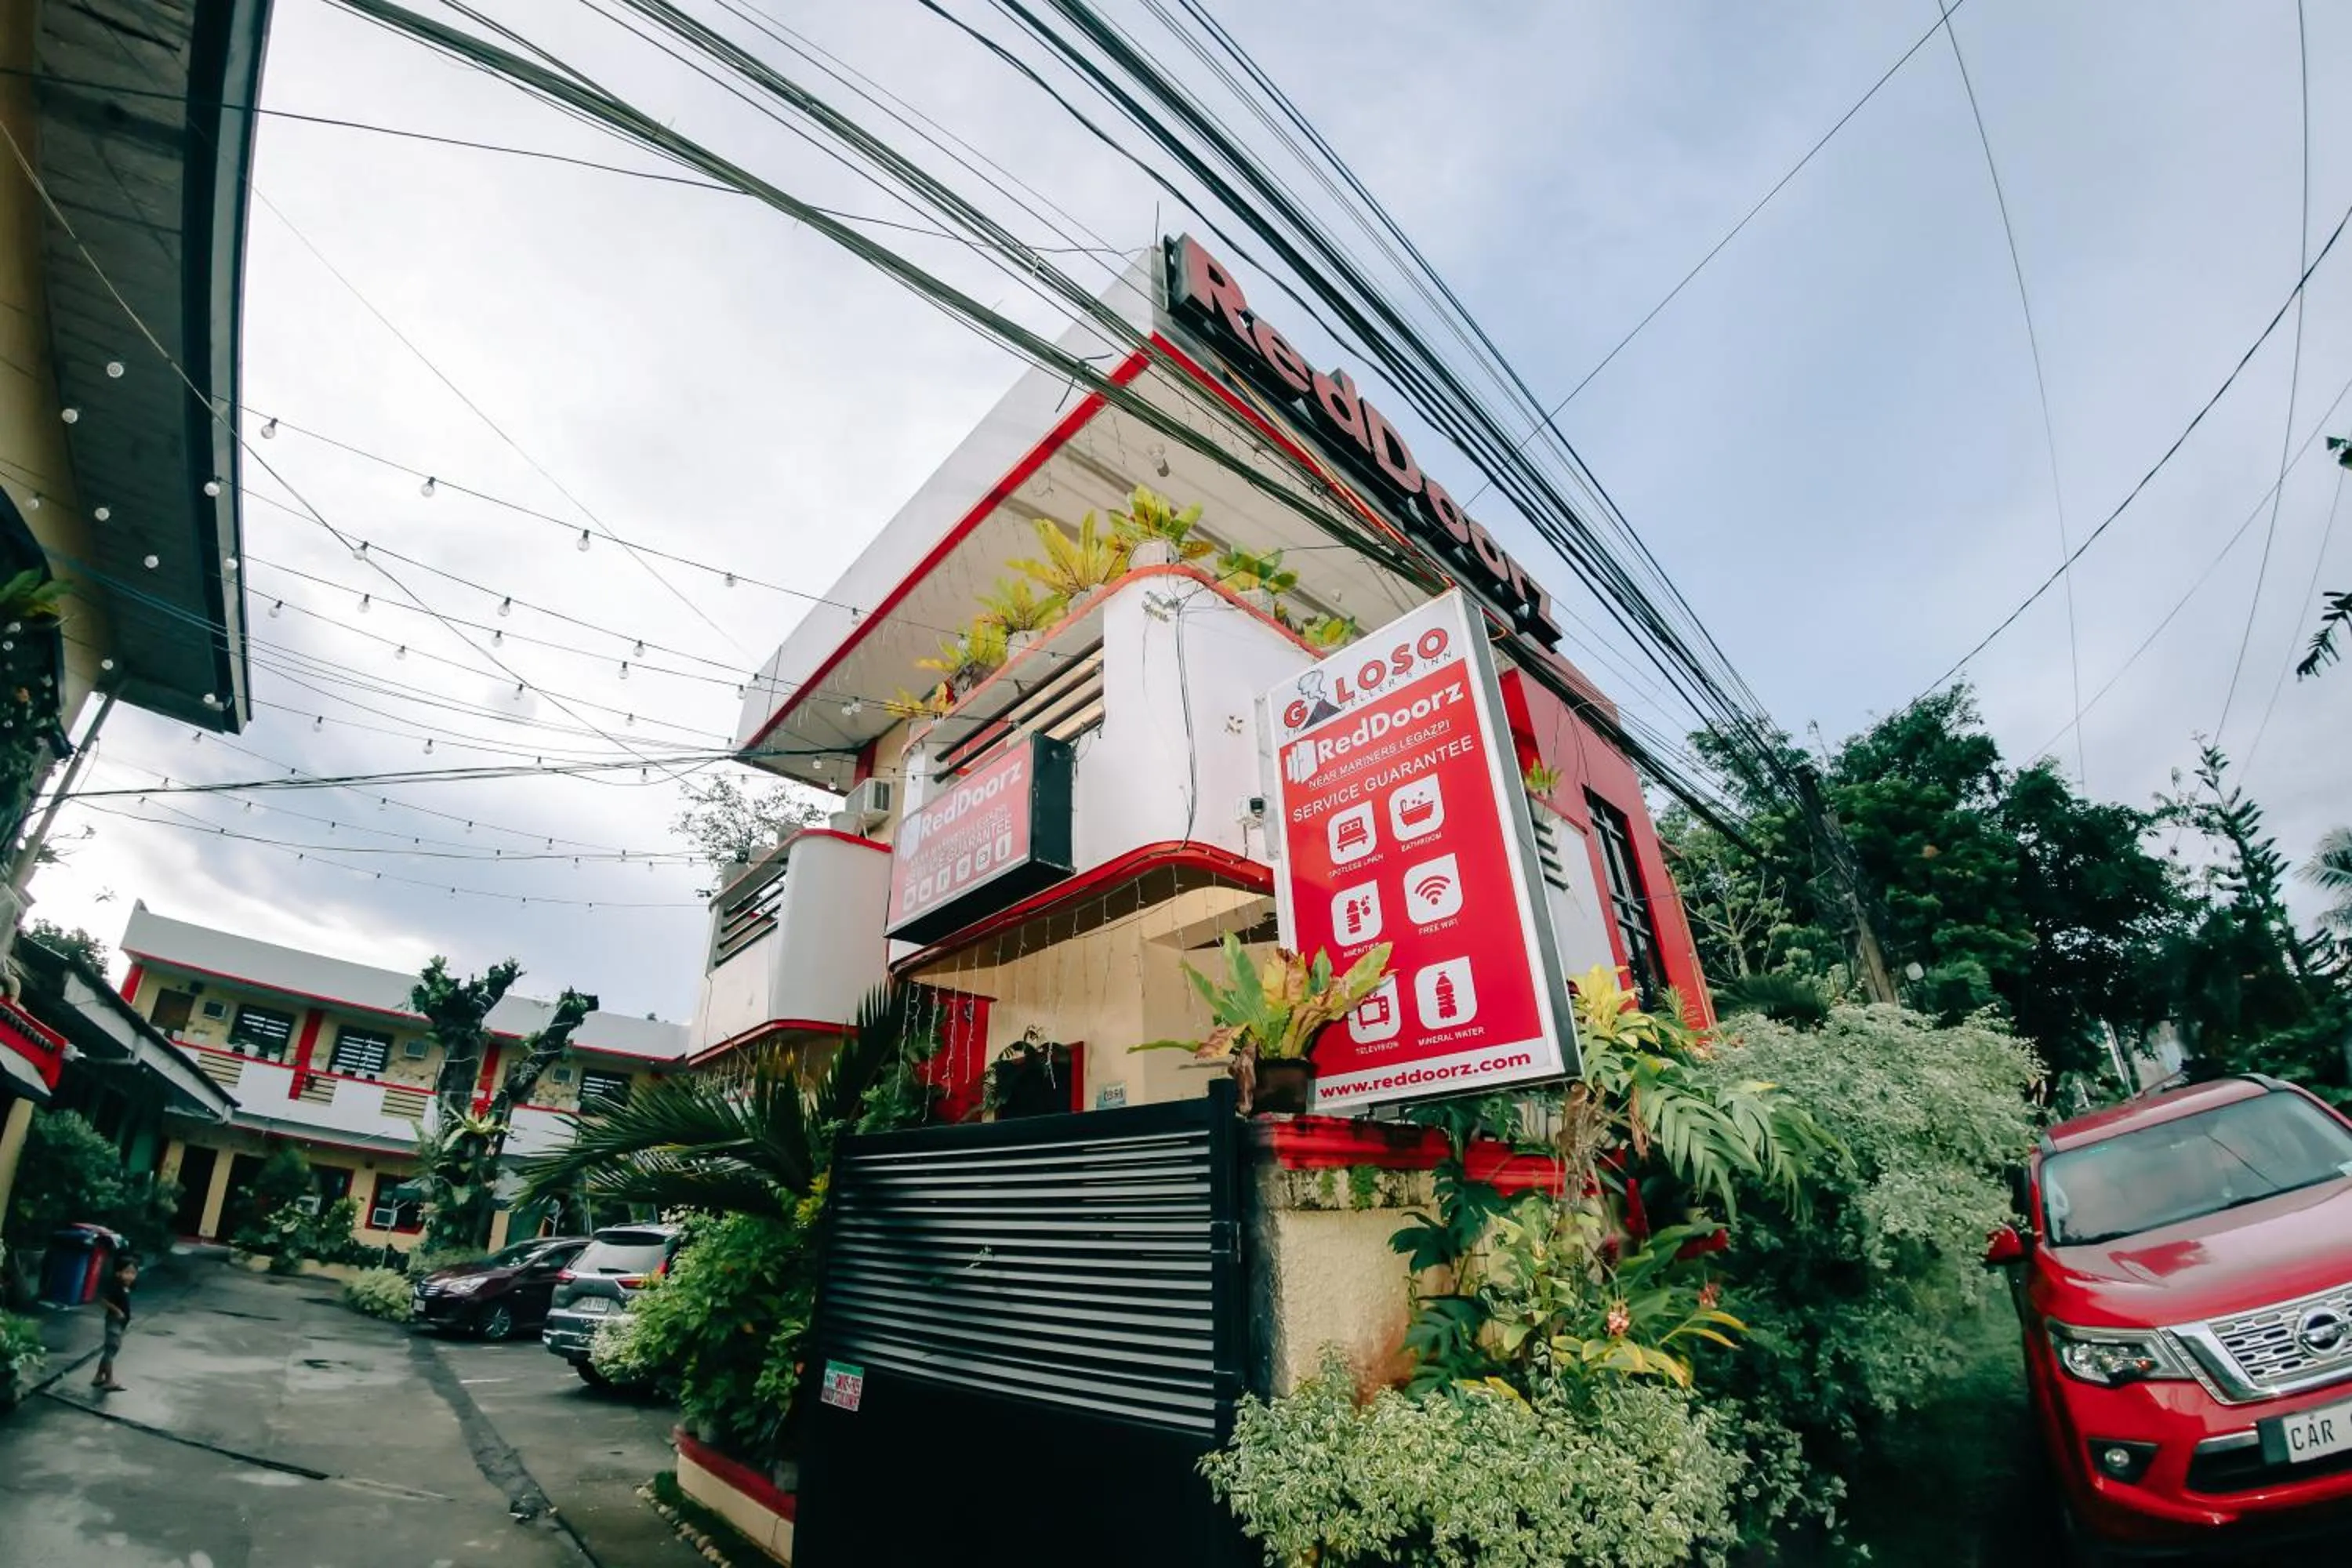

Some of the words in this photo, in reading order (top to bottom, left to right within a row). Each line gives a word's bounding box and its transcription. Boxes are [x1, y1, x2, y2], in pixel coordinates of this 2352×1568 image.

[1421, 650, 1451, 670] INN
[1318, 681, 1465, 764] RedDoorz
[1308, 769, 1338, 789] NEAR
[1338, 744, 1396, 775] MARINERS
[1399, 719, 1450, 748] LEGAZPI
[1293, 782, 1361, 822] SERVICE
[1365, 734, 1475, 792] GUARANTEE
[920, 760, 1022, 841] RedDoorz
[1401, 831, 1443, 852] BATHROOM
[1418, 921, 1439, 936] FREE
[1354, 1040, 1400, 1054] TELEVISION
[1417, 1033, 1454, 1047] MINERAL
[1454, 1025, 1486, 1040] WATER
[1319, 1052, 1531, 1098] www.reddoorz.com
[2290, 1418, 2336, 1451] CAR
